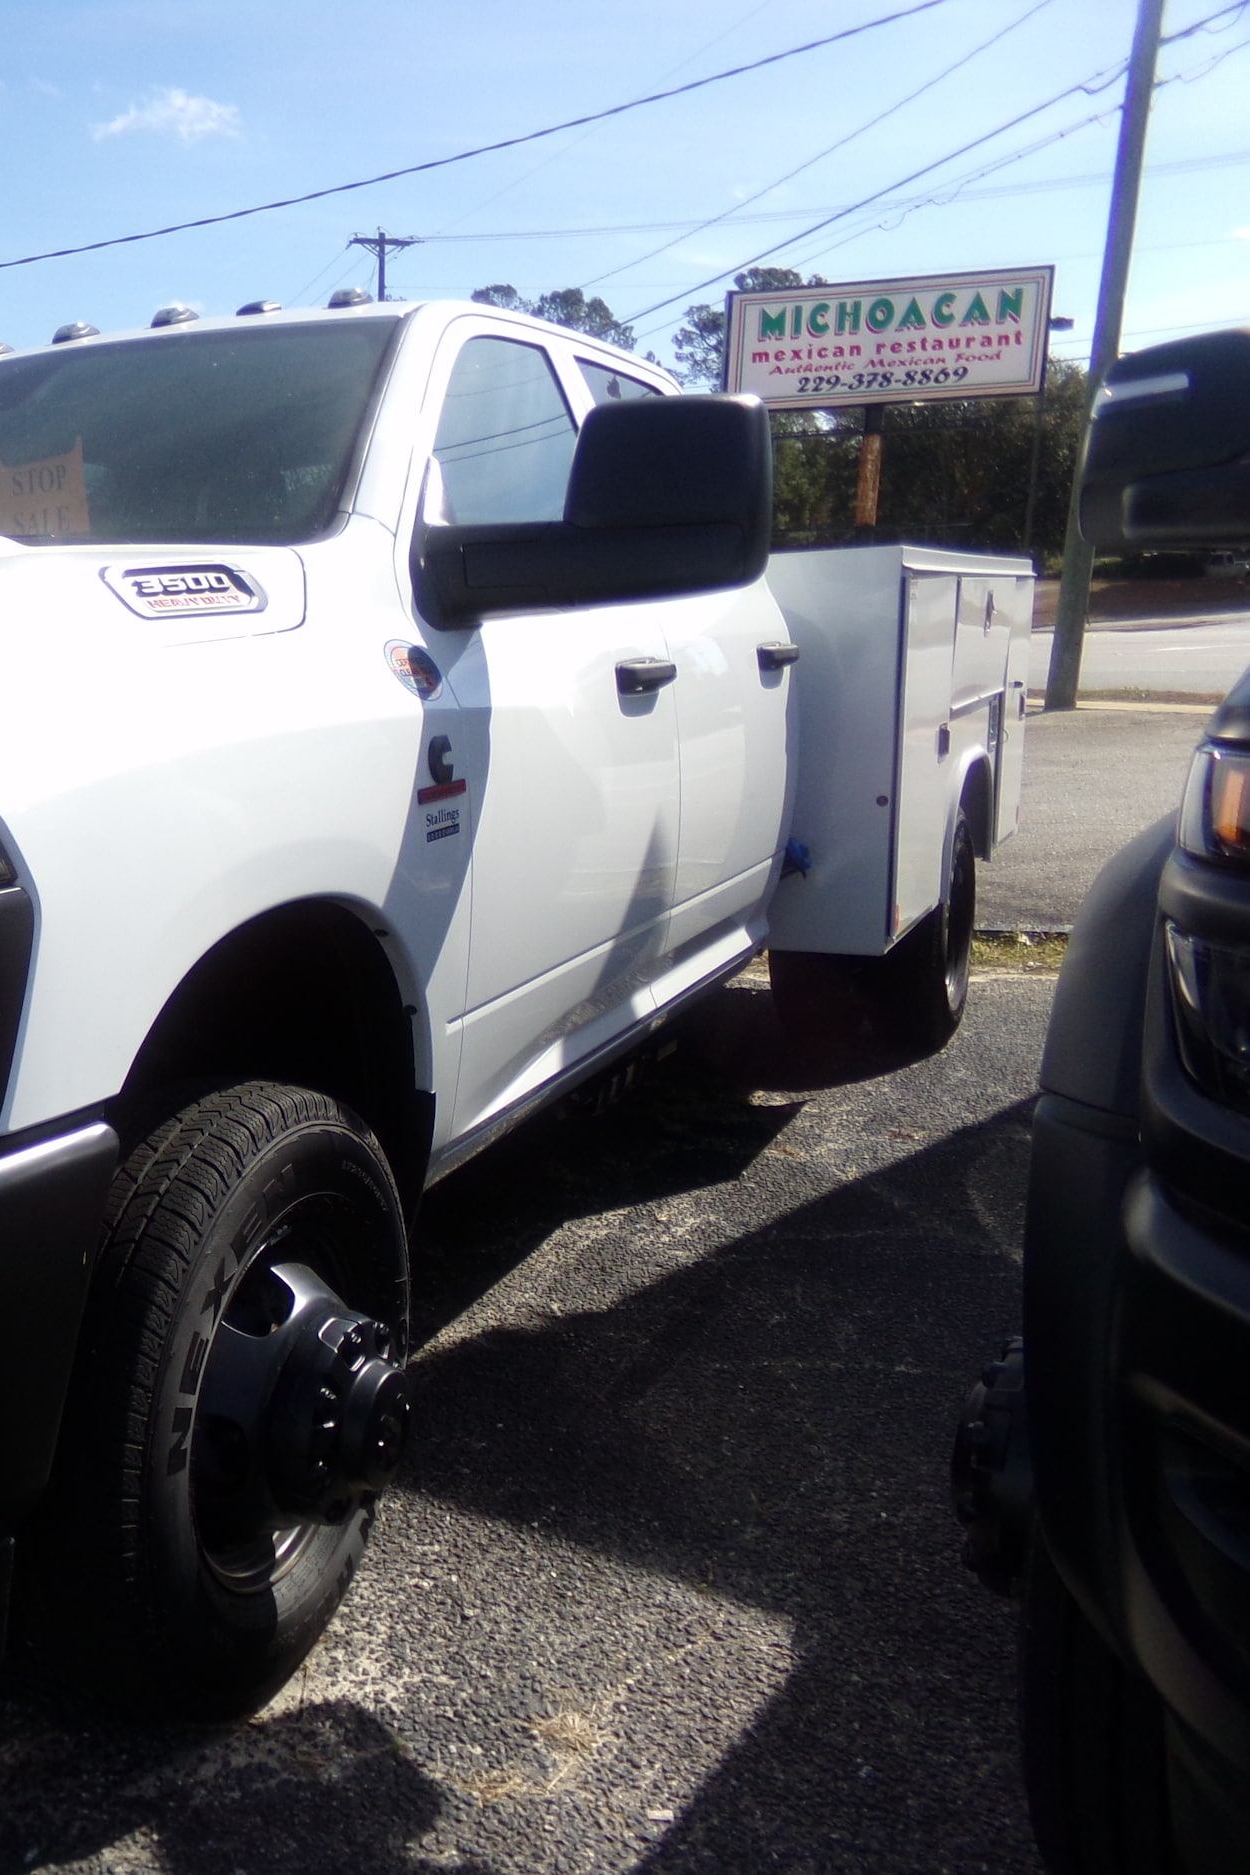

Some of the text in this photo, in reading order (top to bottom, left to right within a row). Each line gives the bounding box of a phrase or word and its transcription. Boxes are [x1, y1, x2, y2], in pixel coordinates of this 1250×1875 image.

[758, 288, 1024, 342] MICHOACAN
[752, 330, 1024, 364] mexican restaurant
[769, 351, 1003, 376] Authentic Mexican Food
[797, 366, 969, 393] 229-378-8869
[12, 464, 67, 497] STOP
[13, 506, 71, 535] SALE
[131, 574, 233, 598] 3500
[425, 808, 460, 828] Stallings
[166, 1161, 296, 1477] NEXEN
